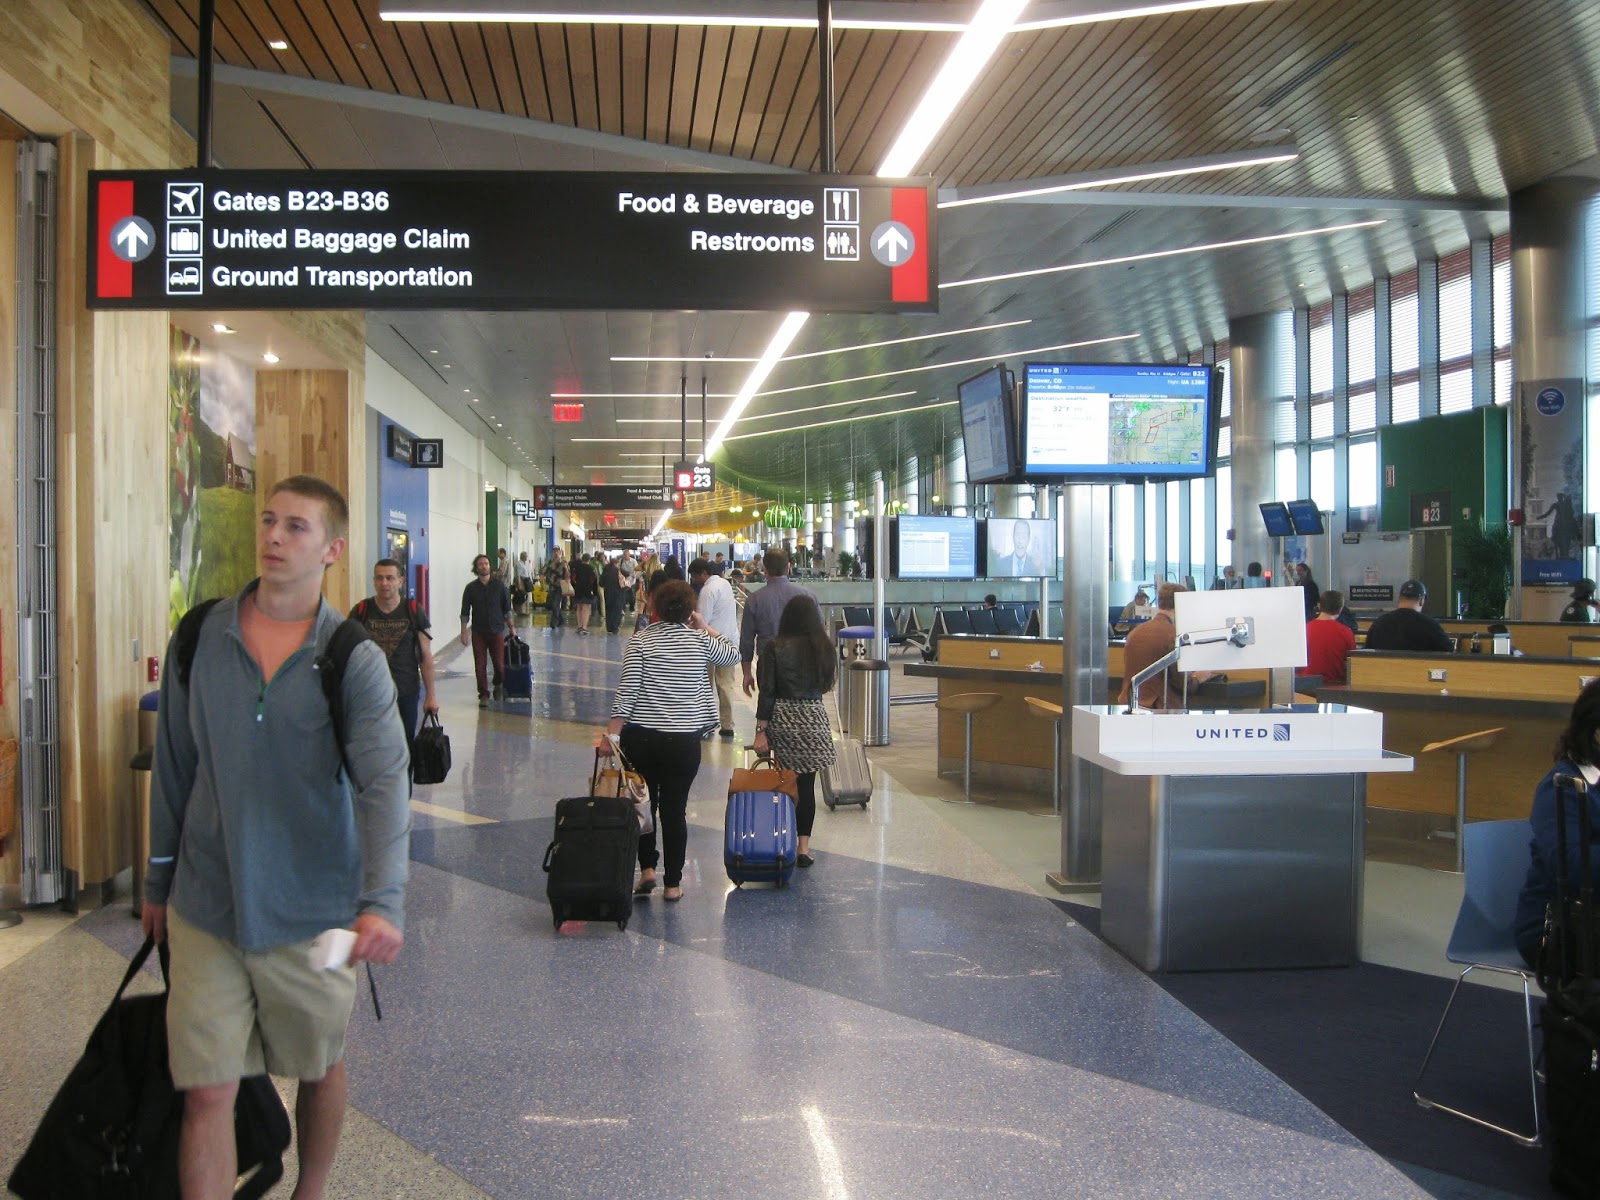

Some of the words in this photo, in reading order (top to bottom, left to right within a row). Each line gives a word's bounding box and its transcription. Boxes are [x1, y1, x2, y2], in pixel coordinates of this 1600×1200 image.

[214, 191, 280, 211] Gates
[288, 191, 389, 211] B23-B36
[619, 193, 675, 213] Food
[683, 194, 700, 213] &
[708, 194, 814, 219] Beverage
[213, 229, 286, 248] United
[295, 229, 396, 253] Baggage
[404, 229, 469, 248] Claim
[692, 231, 814, 252] Restrooms
[212, 266, 298, 286] Ground
[306, 266, 472, 290] Transportation
[693, 466, 711, 474] Gate
[678, 473, 691, 488] B
[693, 474, 712, 488] 23
[1423, 508, 1429, 521] B
[1430, 508, 1440, 521] 23
[1196, 728, 1268, 739] UNITED
